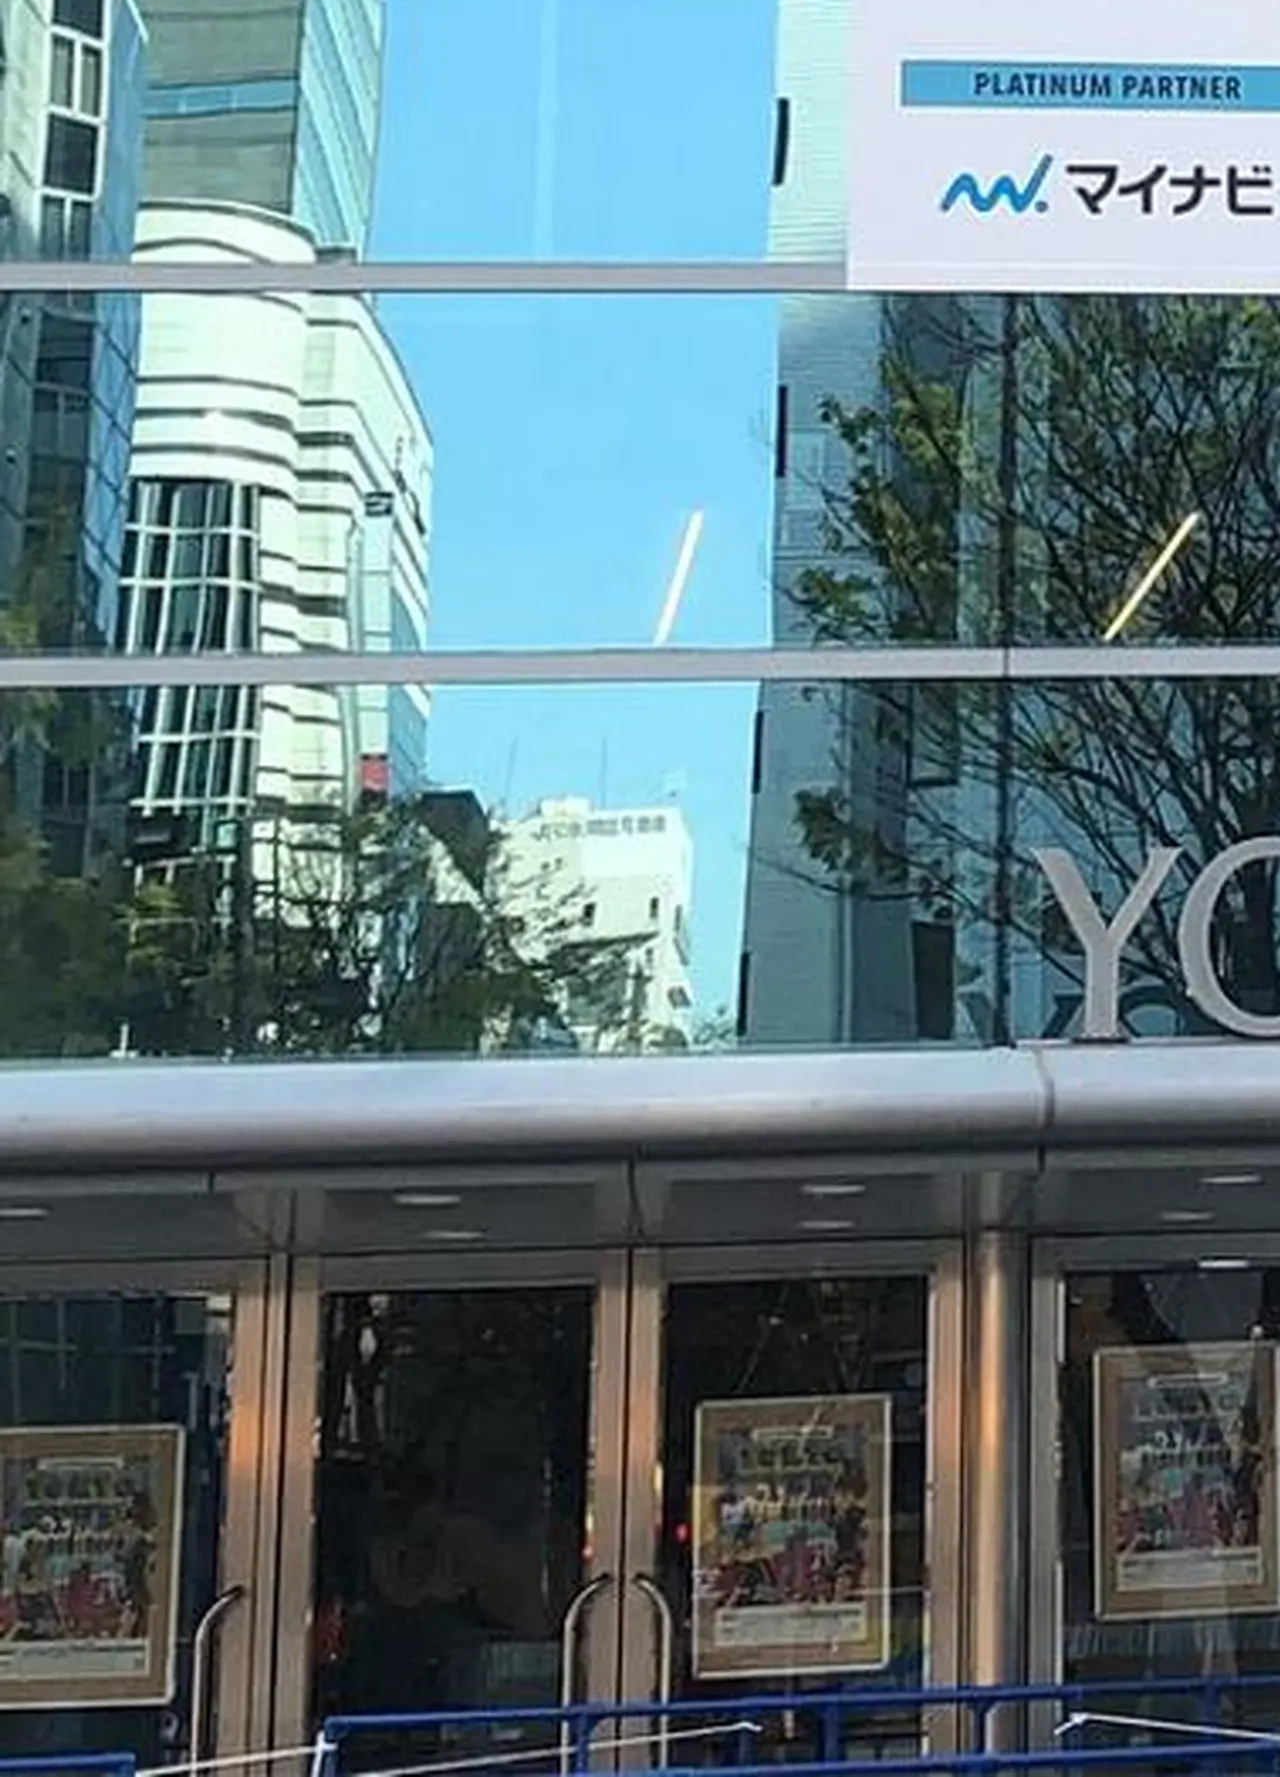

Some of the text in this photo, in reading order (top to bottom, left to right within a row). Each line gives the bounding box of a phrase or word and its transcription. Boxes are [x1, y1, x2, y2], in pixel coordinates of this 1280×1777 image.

[973, 71, 1243, 102] PLATINUM PARTNER
[1065, 163, 1275, 217] マイナビ
